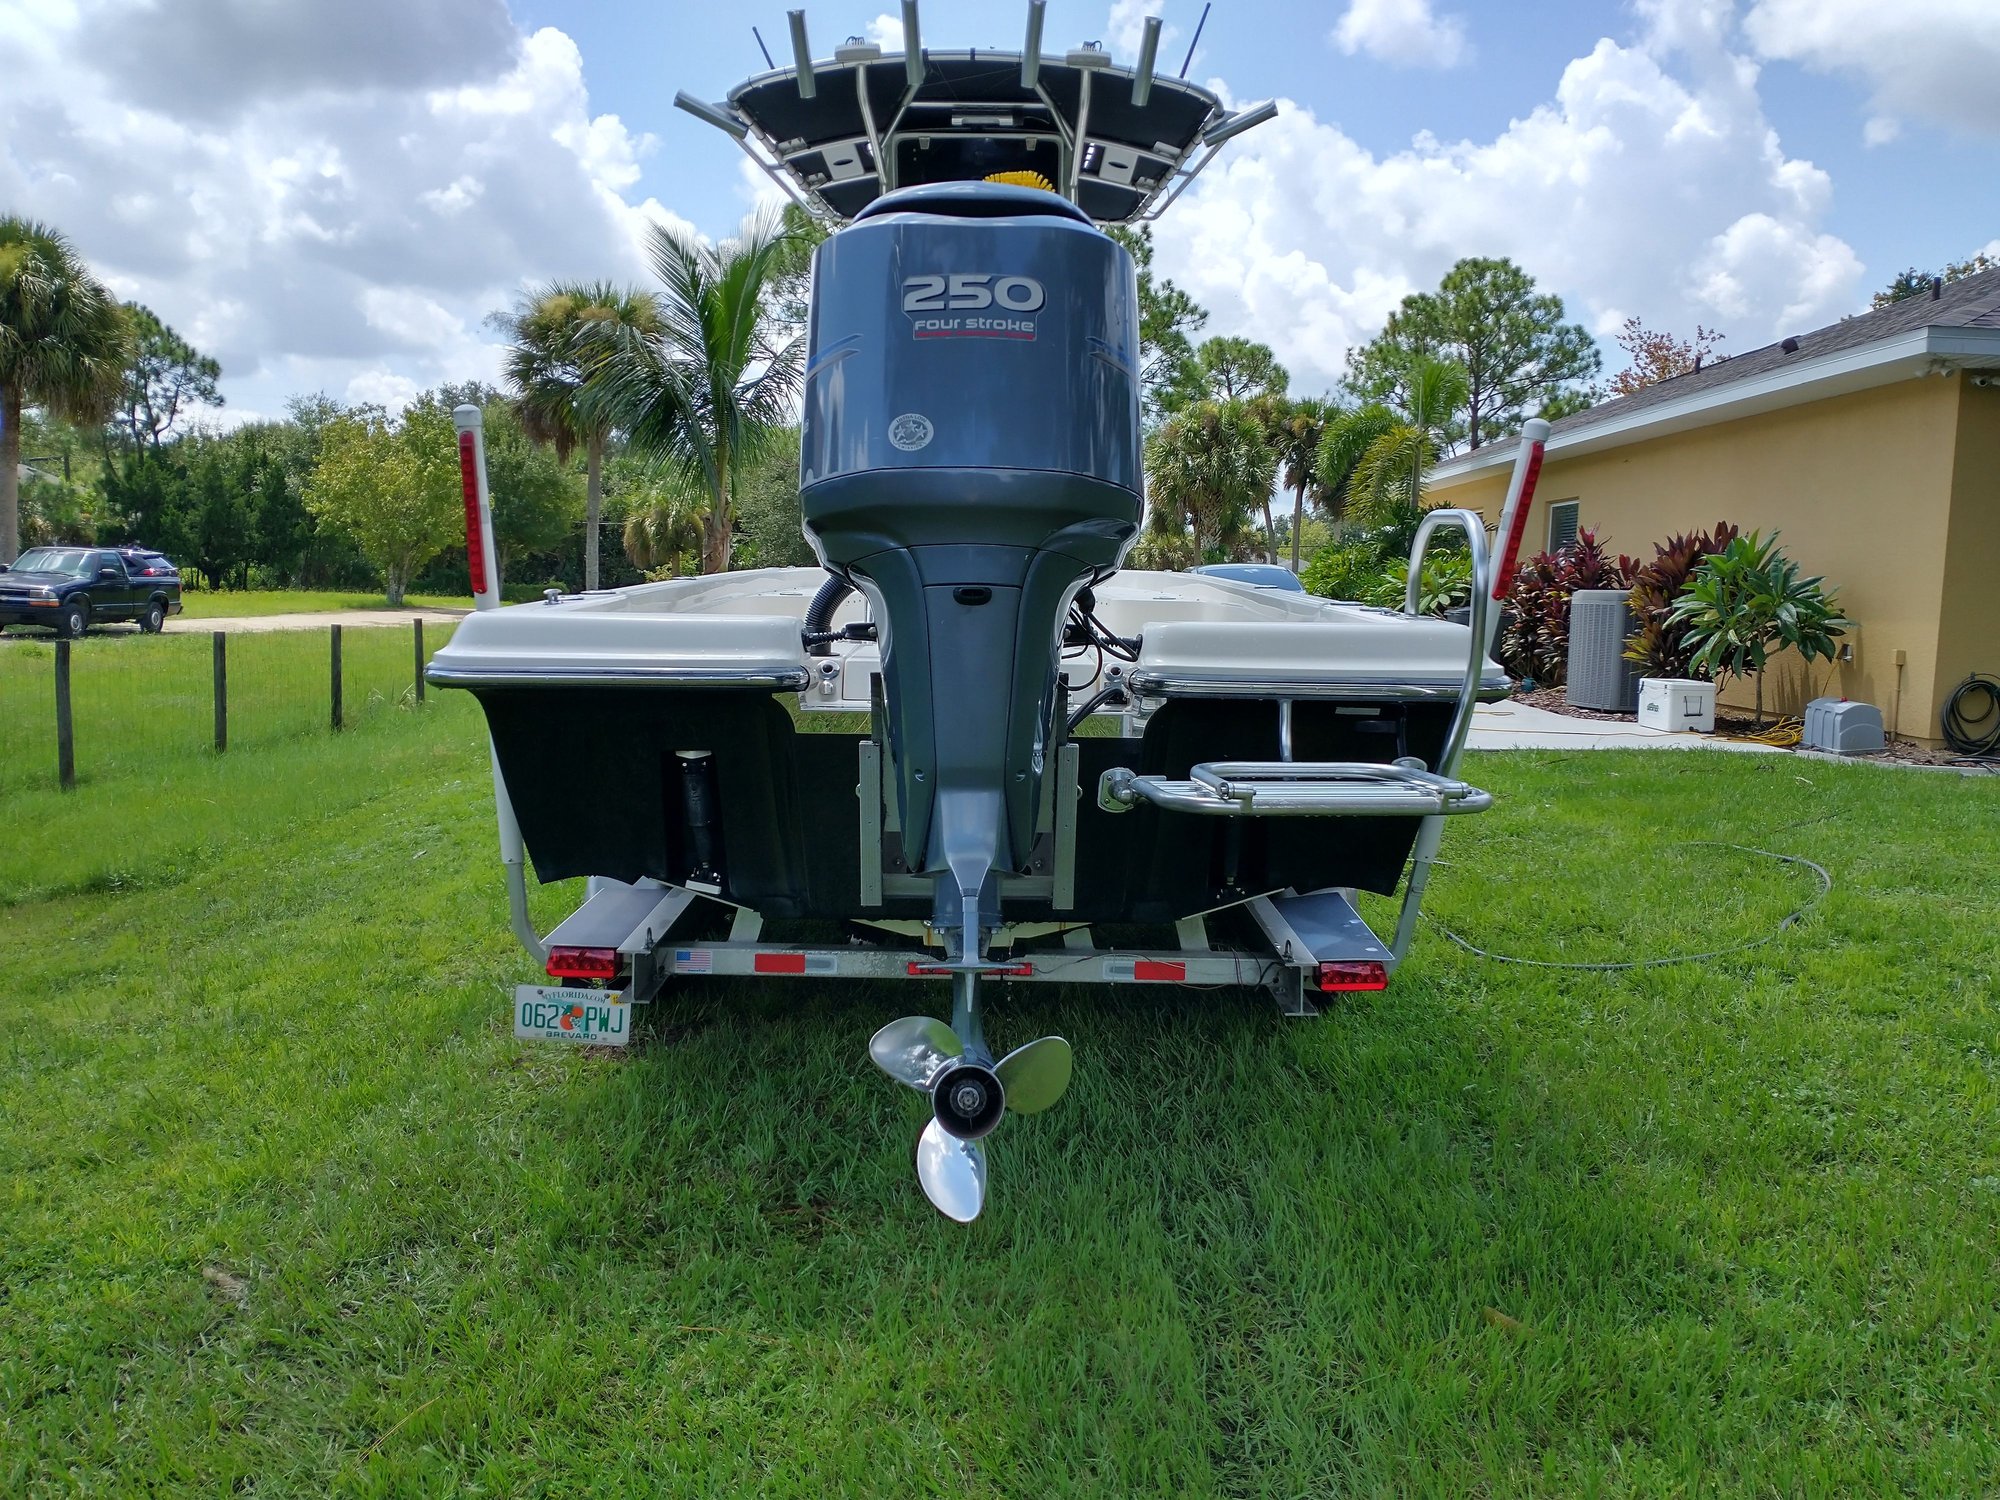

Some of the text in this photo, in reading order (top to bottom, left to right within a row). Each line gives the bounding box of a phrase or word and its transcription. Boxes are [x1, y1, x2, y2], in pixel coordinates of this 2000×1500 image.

[903, 274, 1046, 312] 250
[521, 1002, 623, 1033] 062 PWJ
[545, 1030, 598, 1040] BREVARD
